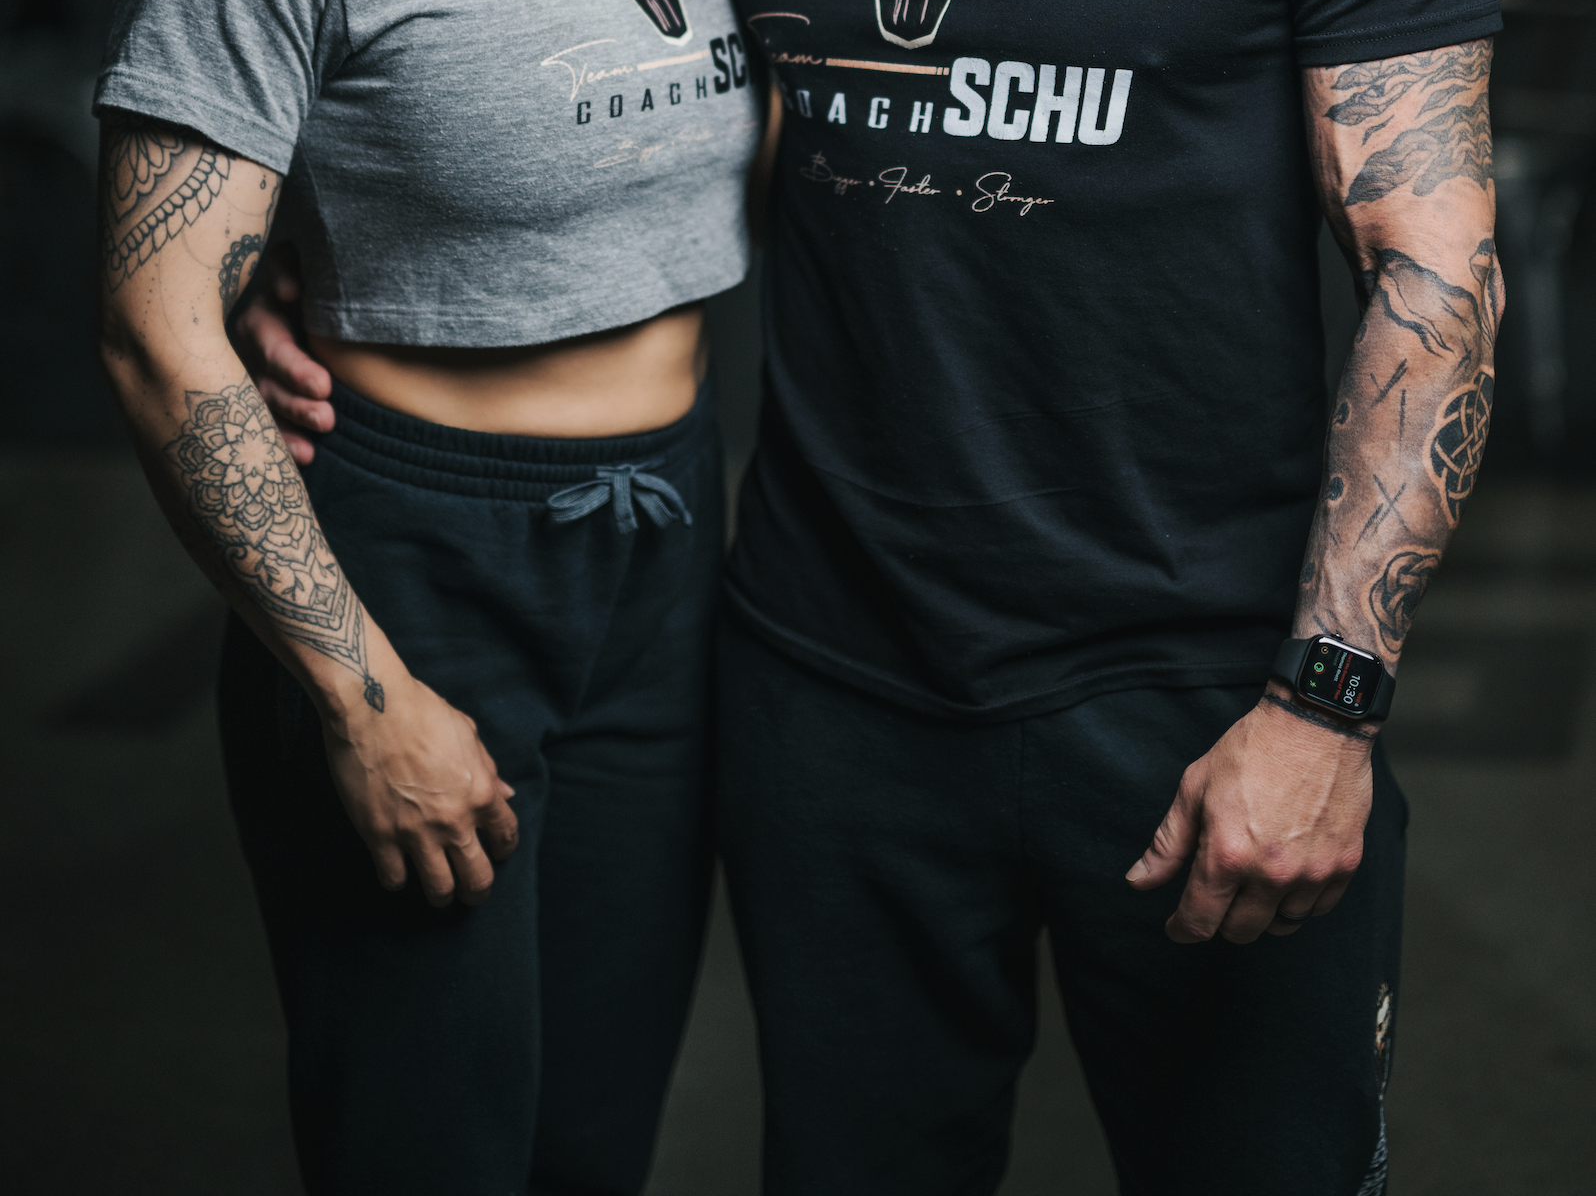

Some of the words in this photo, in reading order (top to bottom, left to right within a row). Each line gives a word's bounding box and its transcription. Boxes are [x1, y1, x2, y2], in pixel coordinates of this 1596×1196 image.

[541, 39, 633, 101] Team
[576, 75, 707, 125] COACH
[709, 33, 750, 94] SC
[942, 56, 1134, 147] SCHU
[878, 167, 942, 204] Faster
[971, 171, 1055, 216] Stronger
[1343, 675, 1361, 704] 10:30
